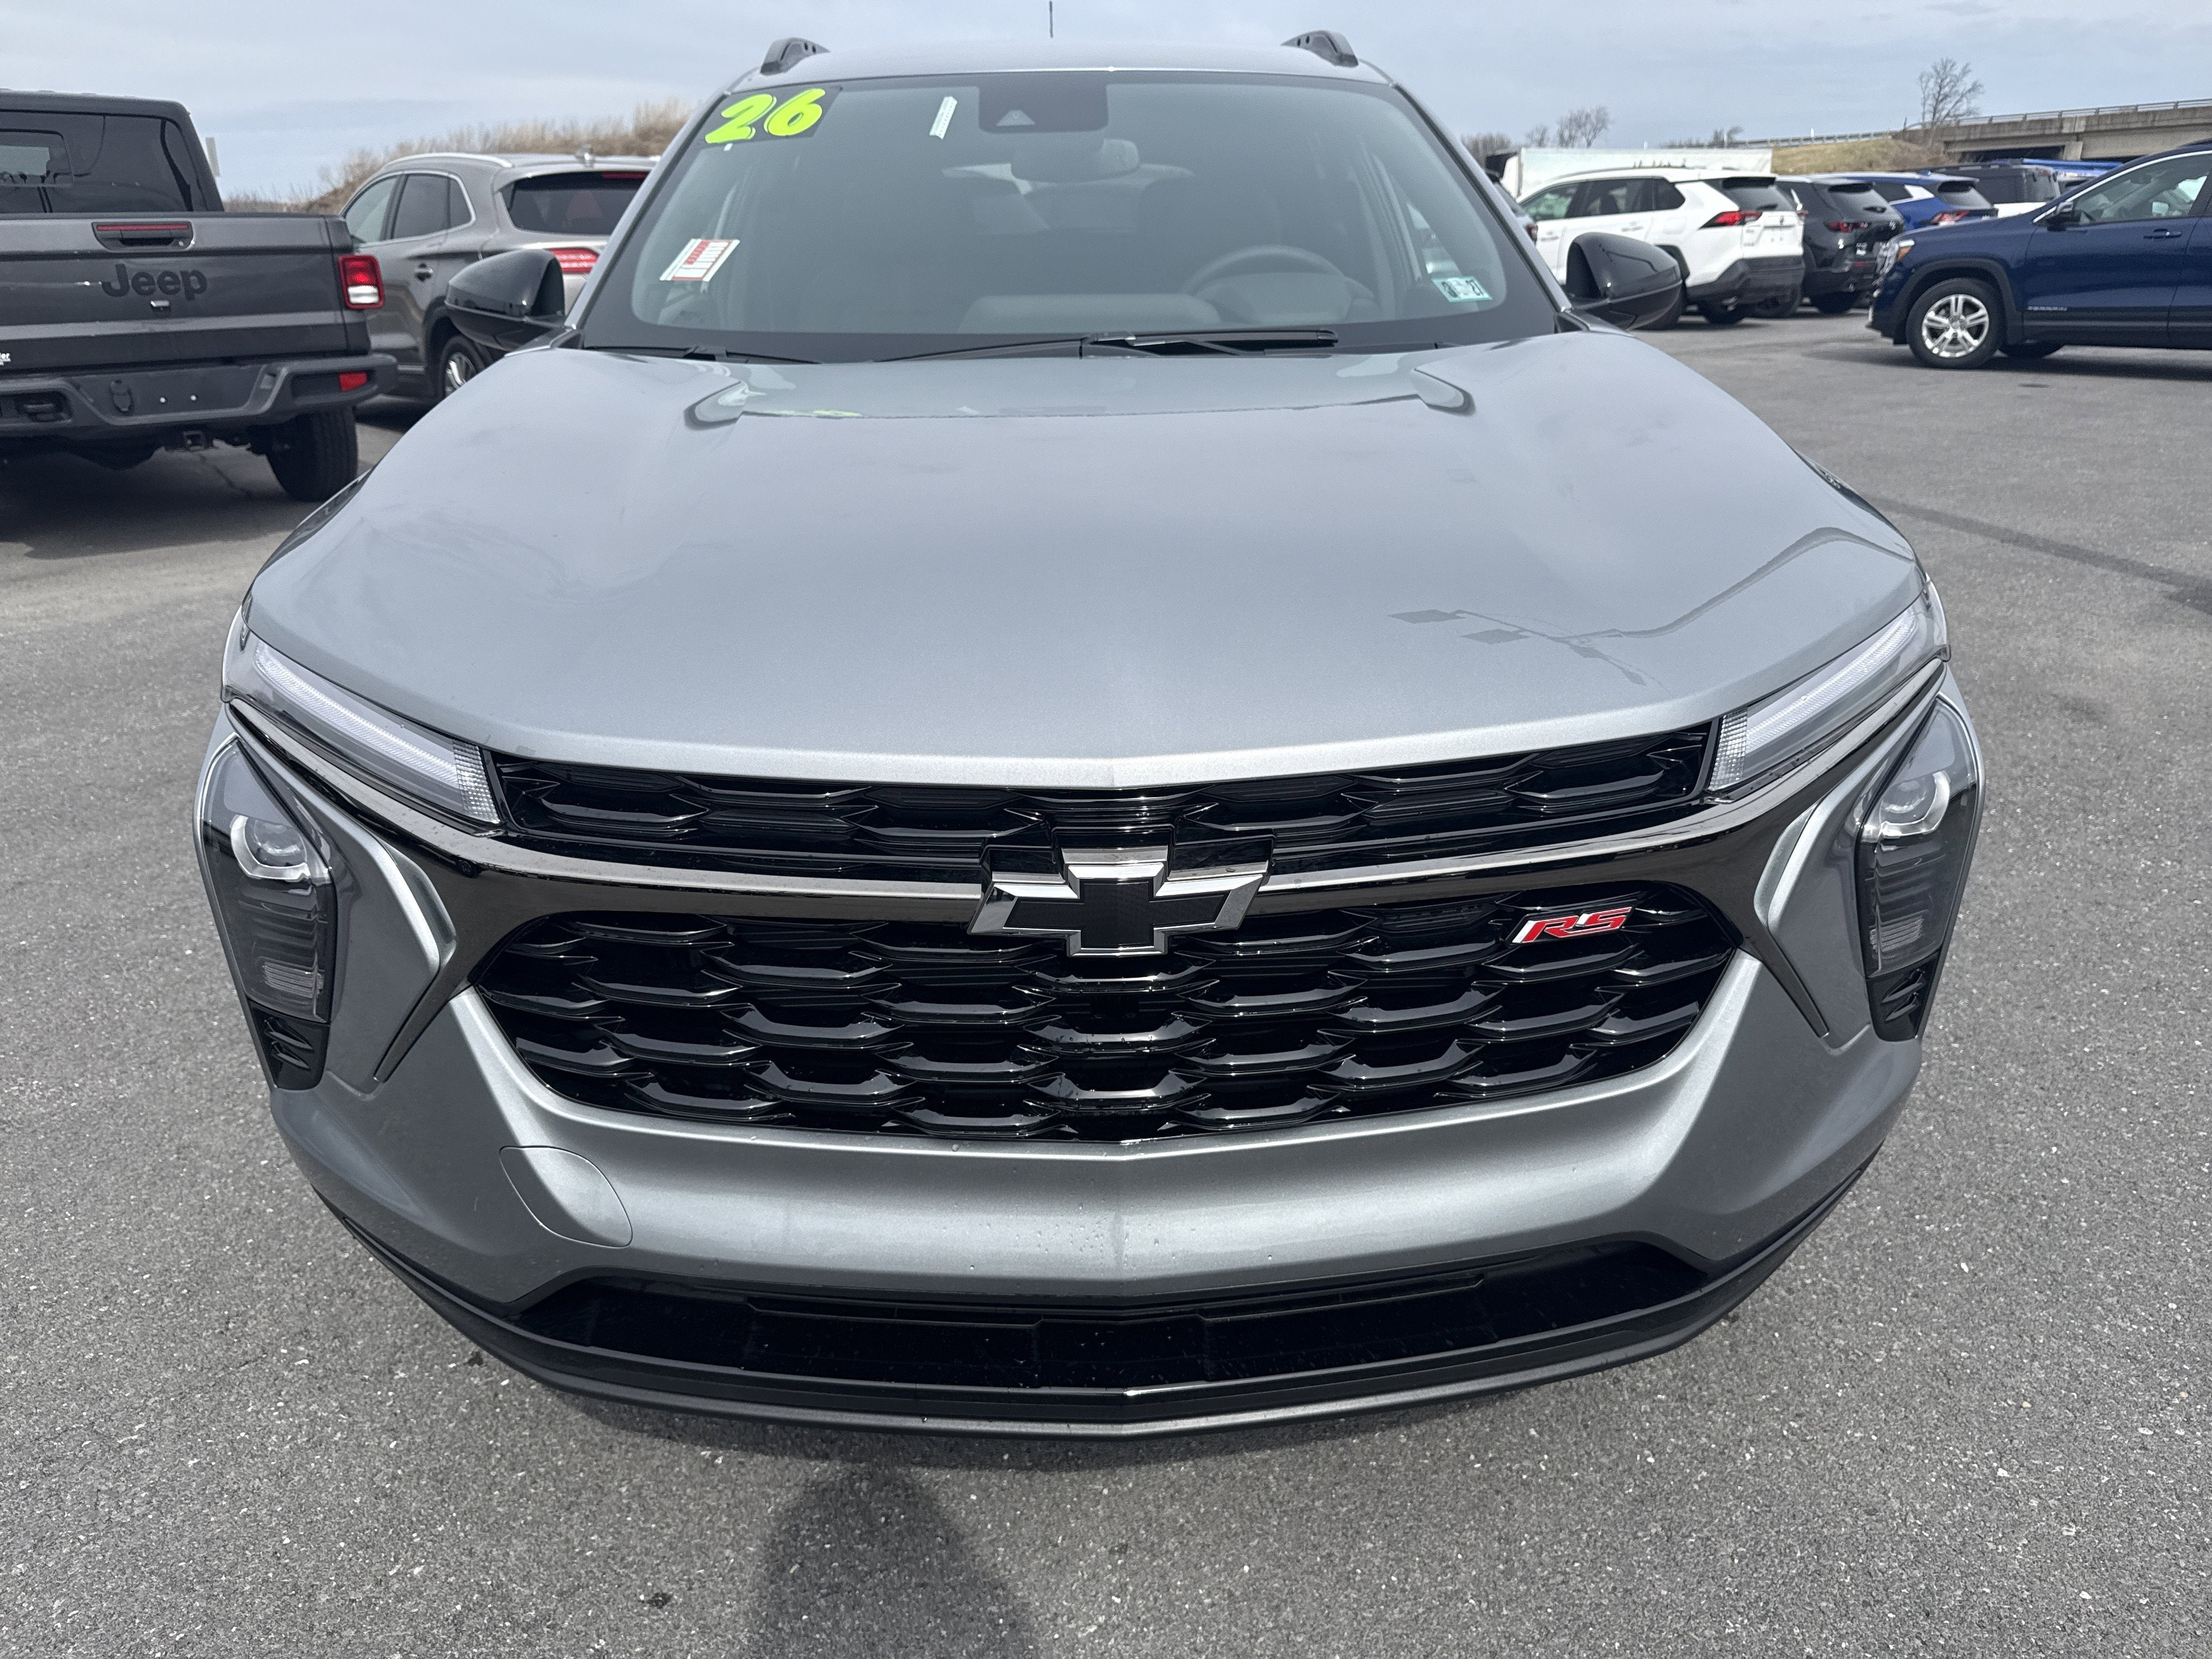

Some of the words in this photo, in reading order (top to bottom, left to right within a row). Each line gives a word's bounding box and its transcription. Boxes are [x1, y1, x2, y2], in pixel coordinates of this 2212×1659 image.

[705, 88, 825, 144] 26
[102, 264, 206, 301] Jeep
[1512, 906, 1633, 944] RS
